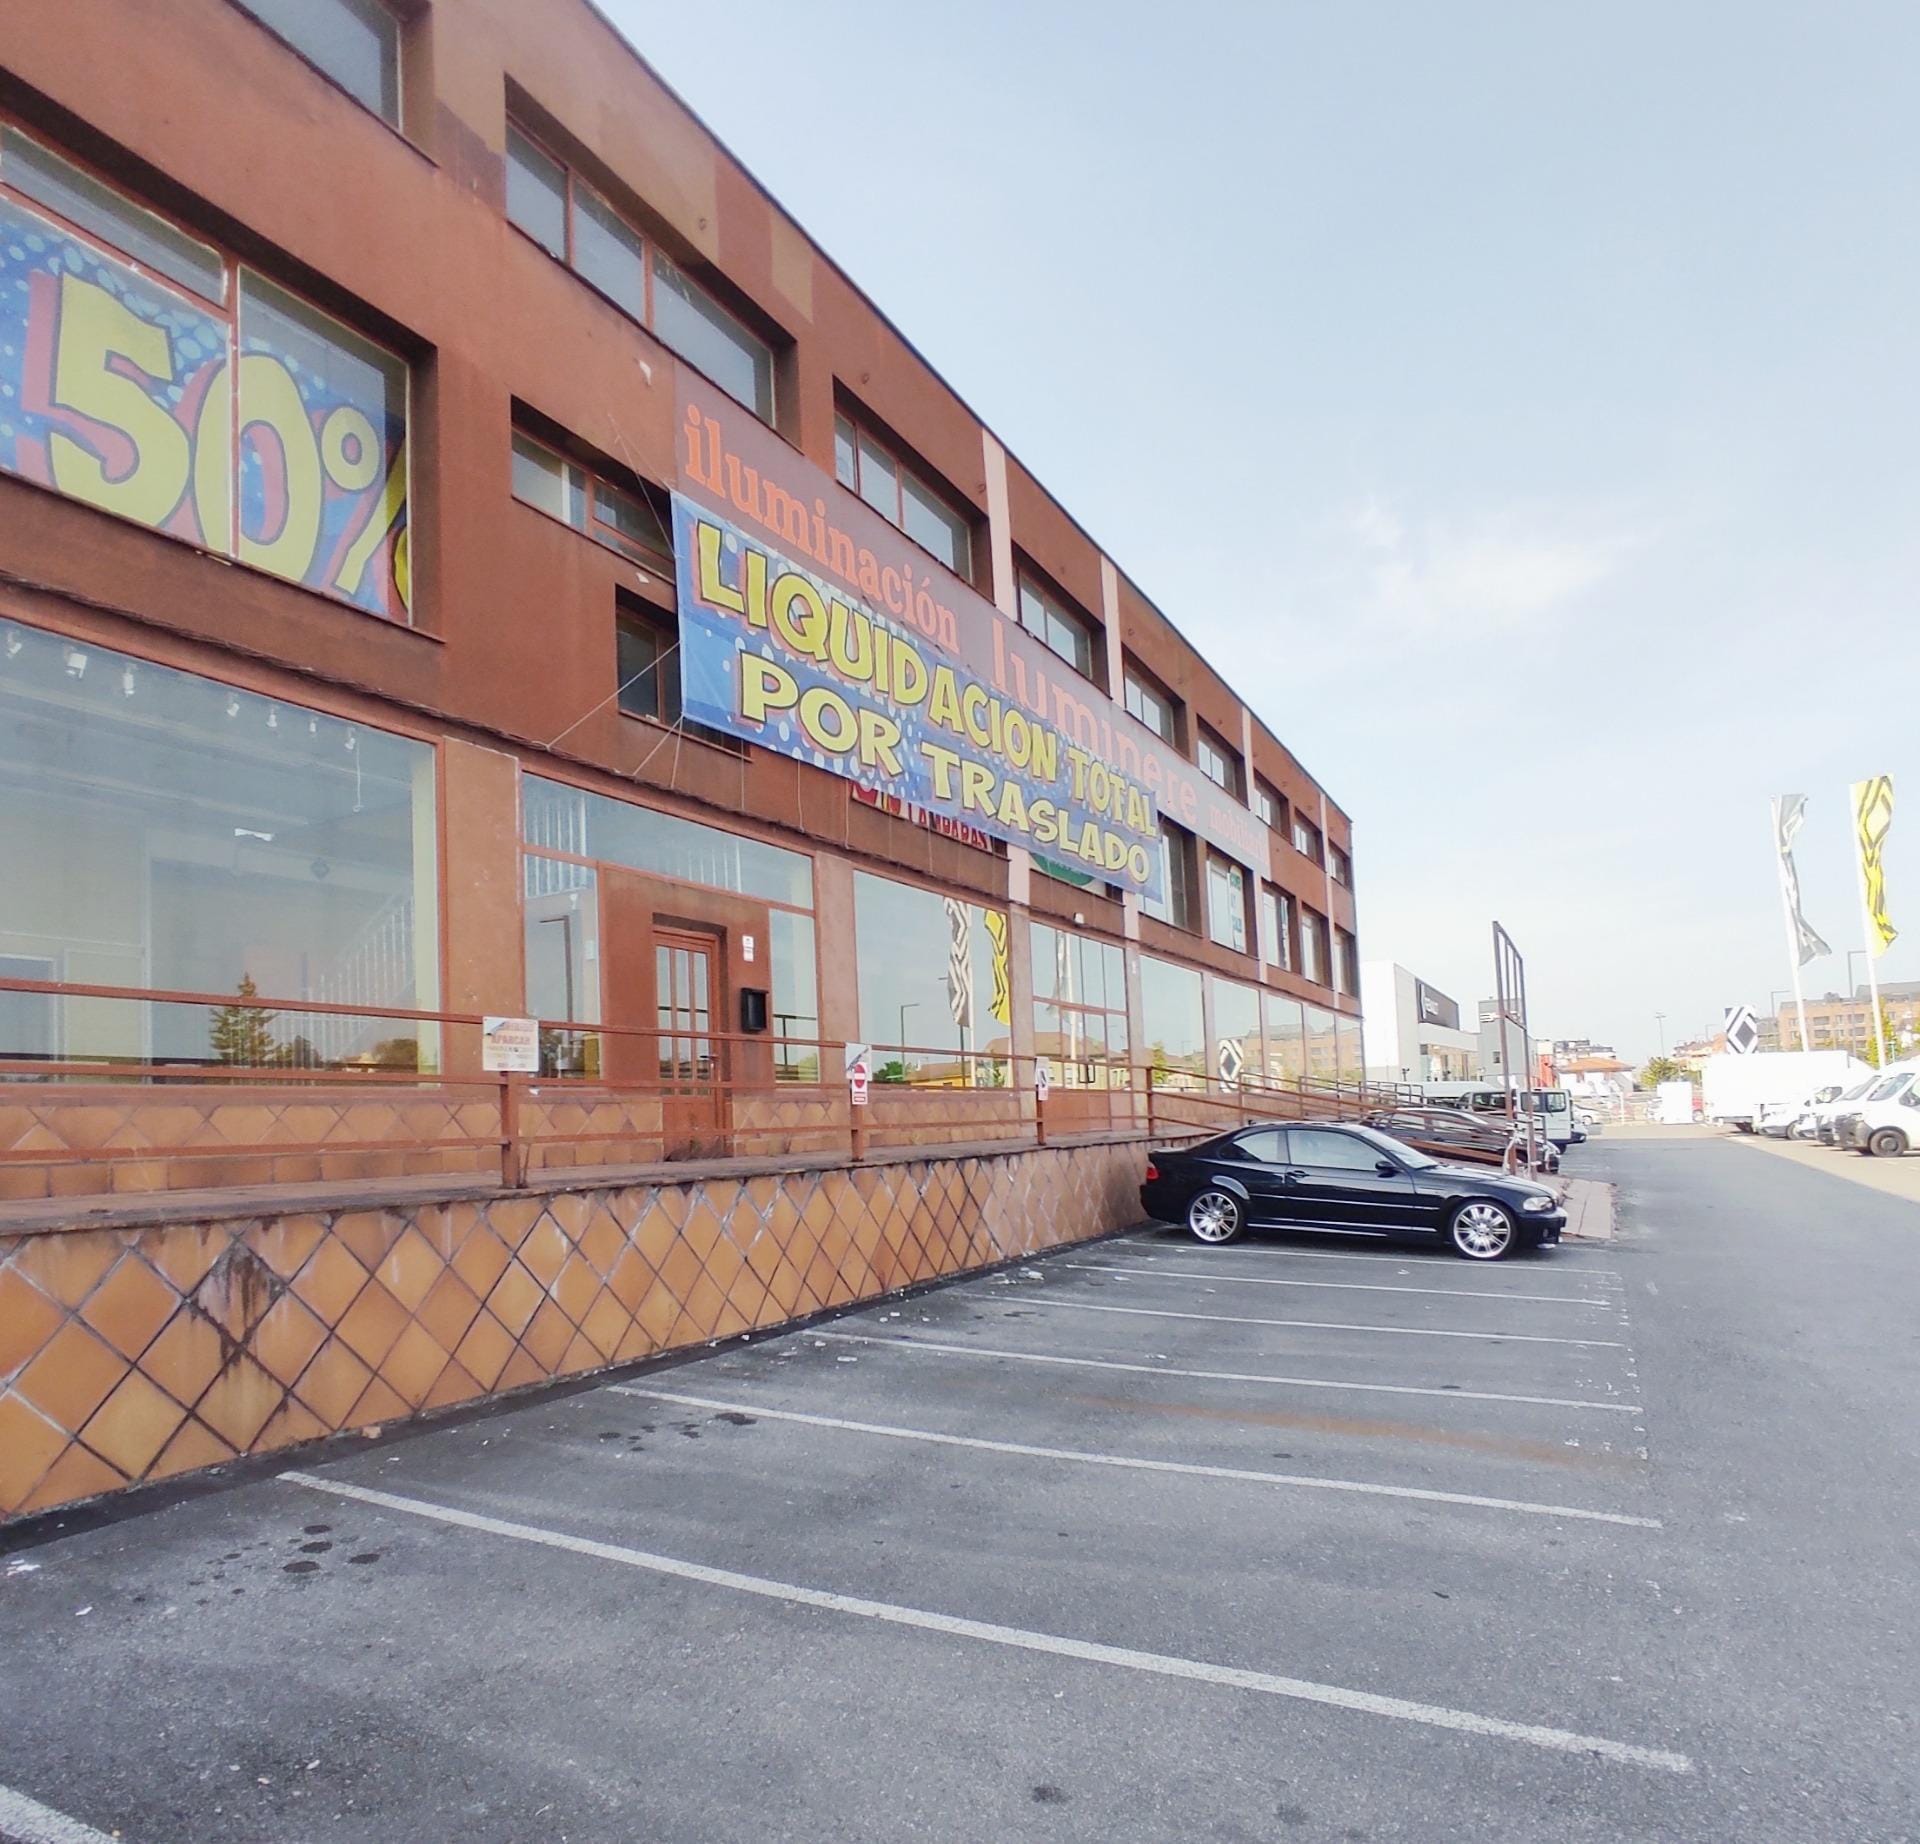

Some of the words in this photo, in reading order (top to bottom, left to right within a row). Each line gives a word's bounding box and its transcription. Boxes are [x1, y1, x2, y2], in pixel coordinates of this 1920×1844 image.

[684, 404, 960, 656] iluminación
[697, 519, 1058, 782] LIQUIDACION
[1066, 745, 1158, 838] TOTAL
[739, 649, 903, 778] POR
[920, 740, 1149, 884] TRASLADO
